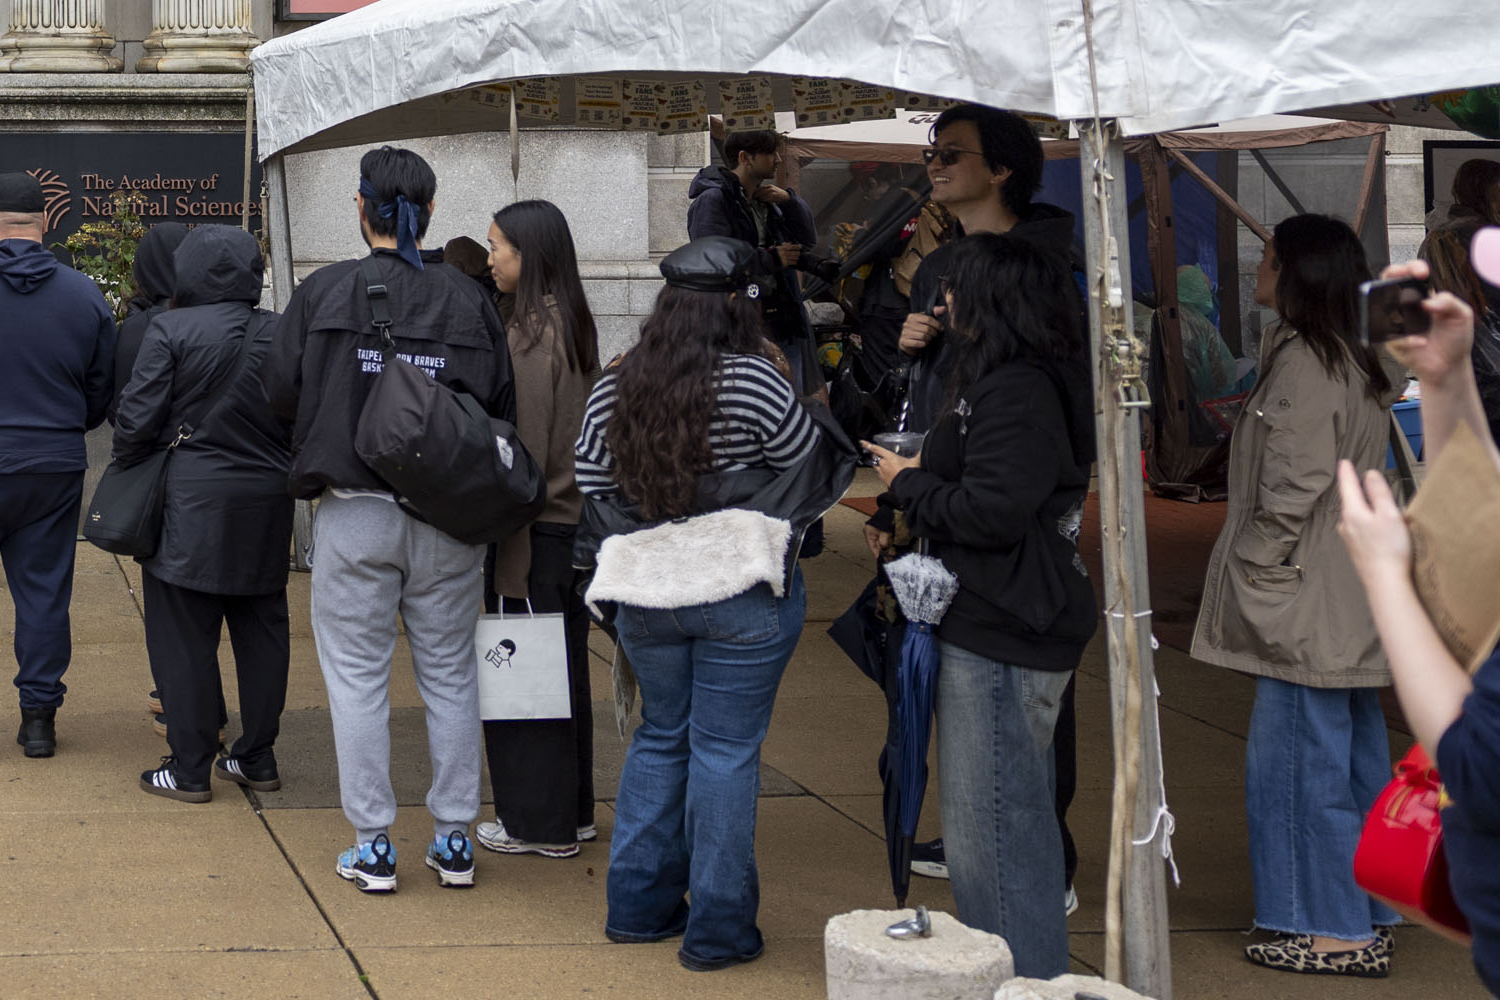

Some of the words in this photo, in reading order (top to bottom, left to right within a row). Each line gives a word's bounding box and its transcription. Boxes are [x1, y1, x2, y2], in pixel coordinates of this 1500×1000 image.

[81, 175, 114, 190] The
[118, 174, 196, 193] Academy
[199, 174, 219, 190] of
[414, 355, 446, 368] BRAVES
